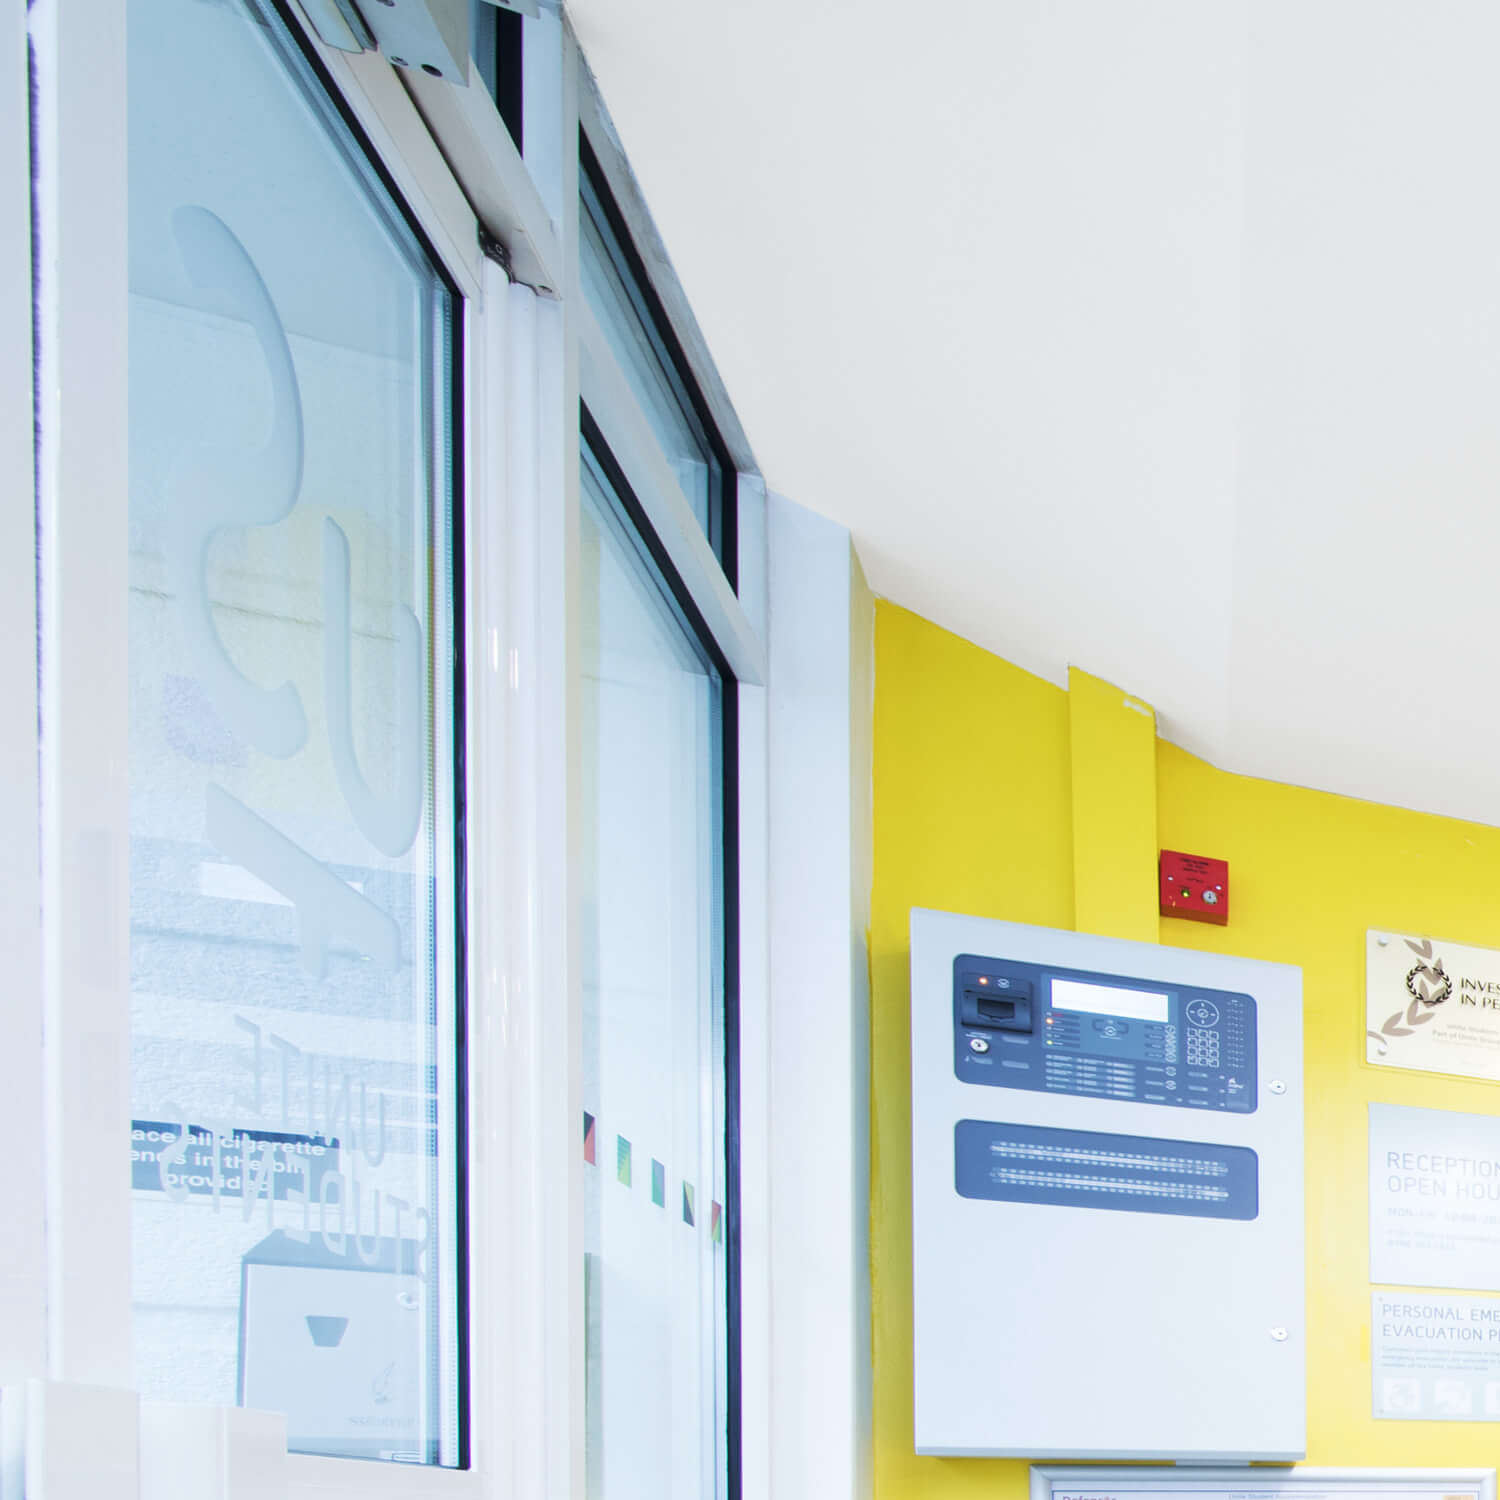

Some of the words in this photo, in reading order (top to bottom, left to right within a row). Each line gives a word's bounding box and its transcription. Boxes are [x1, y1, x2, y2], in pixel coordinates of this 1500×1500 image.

[1460, 993, 1477, 1006] IN
[1387, 1175, 1447, 1197] OPEN
[1382, 1304, 1464, 1321] PERSONAL
[1382, 1324, 1483, 1341] EVACUATION
